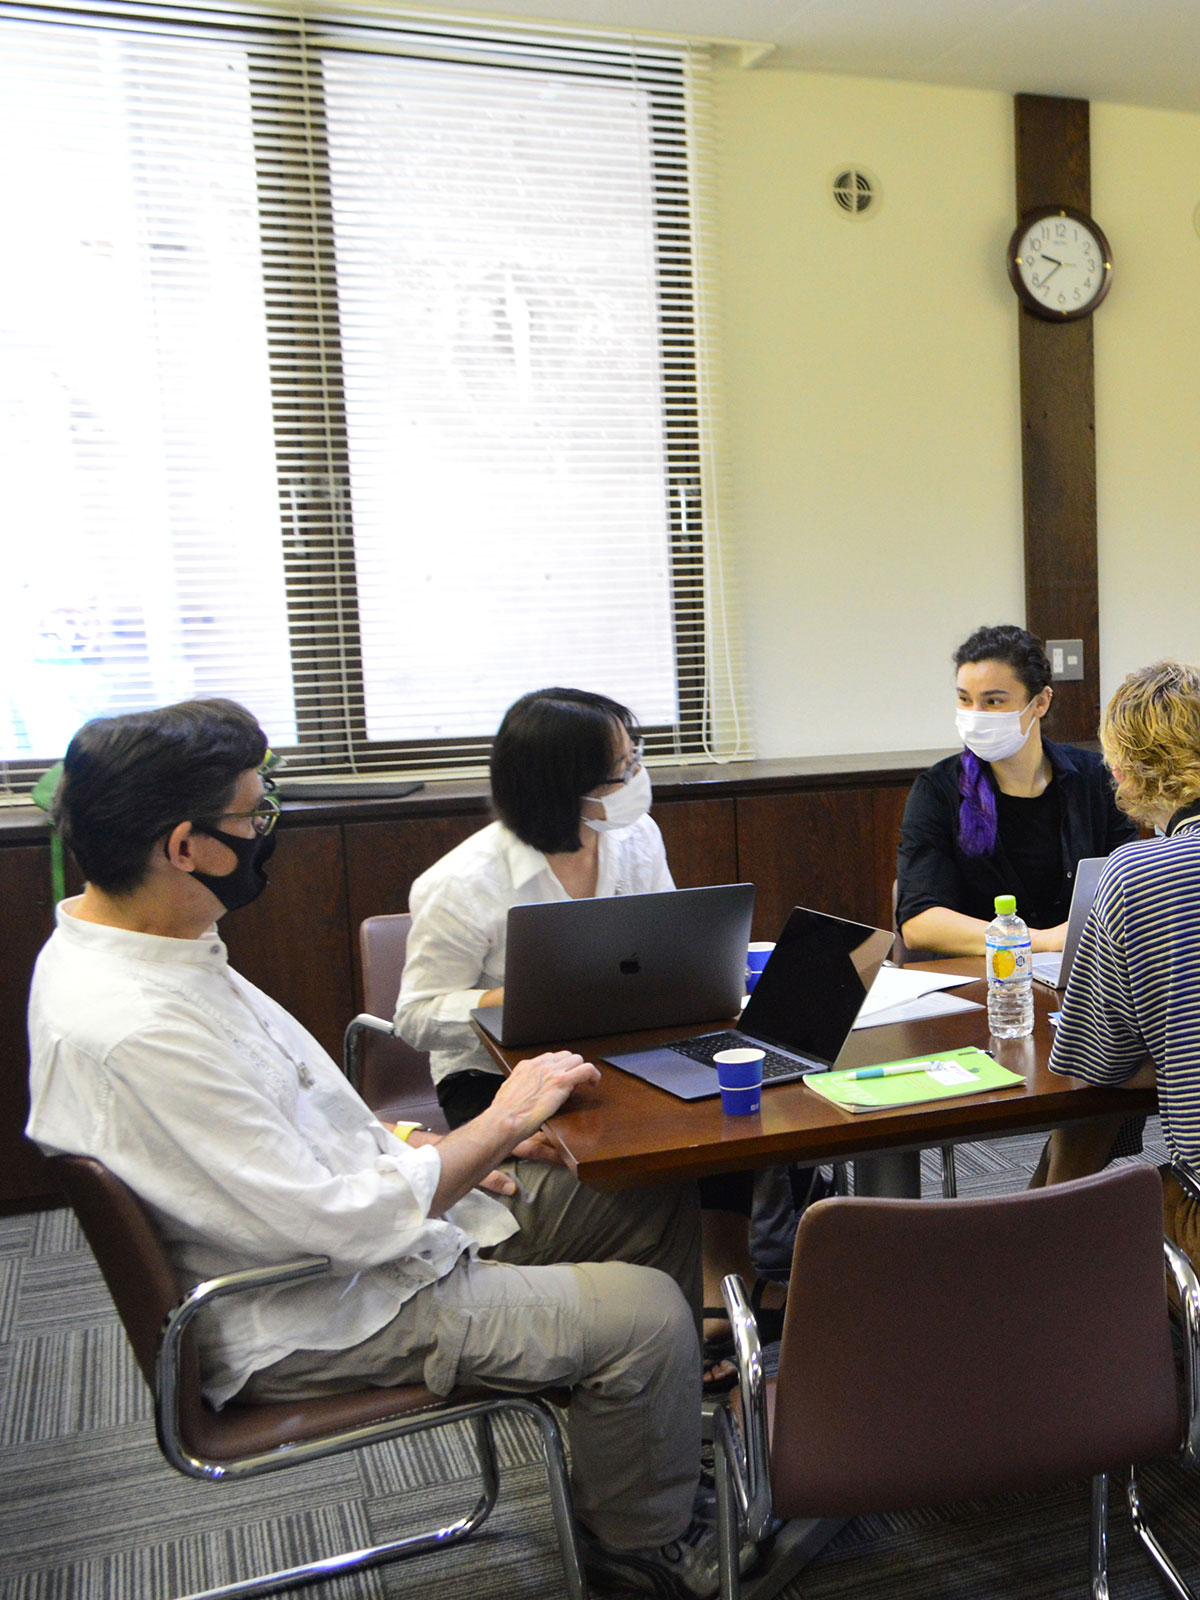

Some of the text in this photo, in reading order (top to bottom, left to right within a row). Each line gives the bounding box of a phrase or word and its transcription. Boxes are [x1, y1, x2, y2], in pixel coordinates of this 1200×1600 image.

[1041, 225, 1050, 240] 11
[1055, 223, 1066, 237] 12
[1073, 229, 1078, 242] 1
[1029, 237, 1041, 251] 10
[1082, 241, 1090, 254] 2
[1026, 255, 1034, 267] 9
[1087, 258, 1095, 273] 3
[1031, 272, 1039, 286] 8
[1083, 277, 1091, 288] 4
[1057, 291, 1066, 304] 6
[1072, 288, 1080, 300] 5
